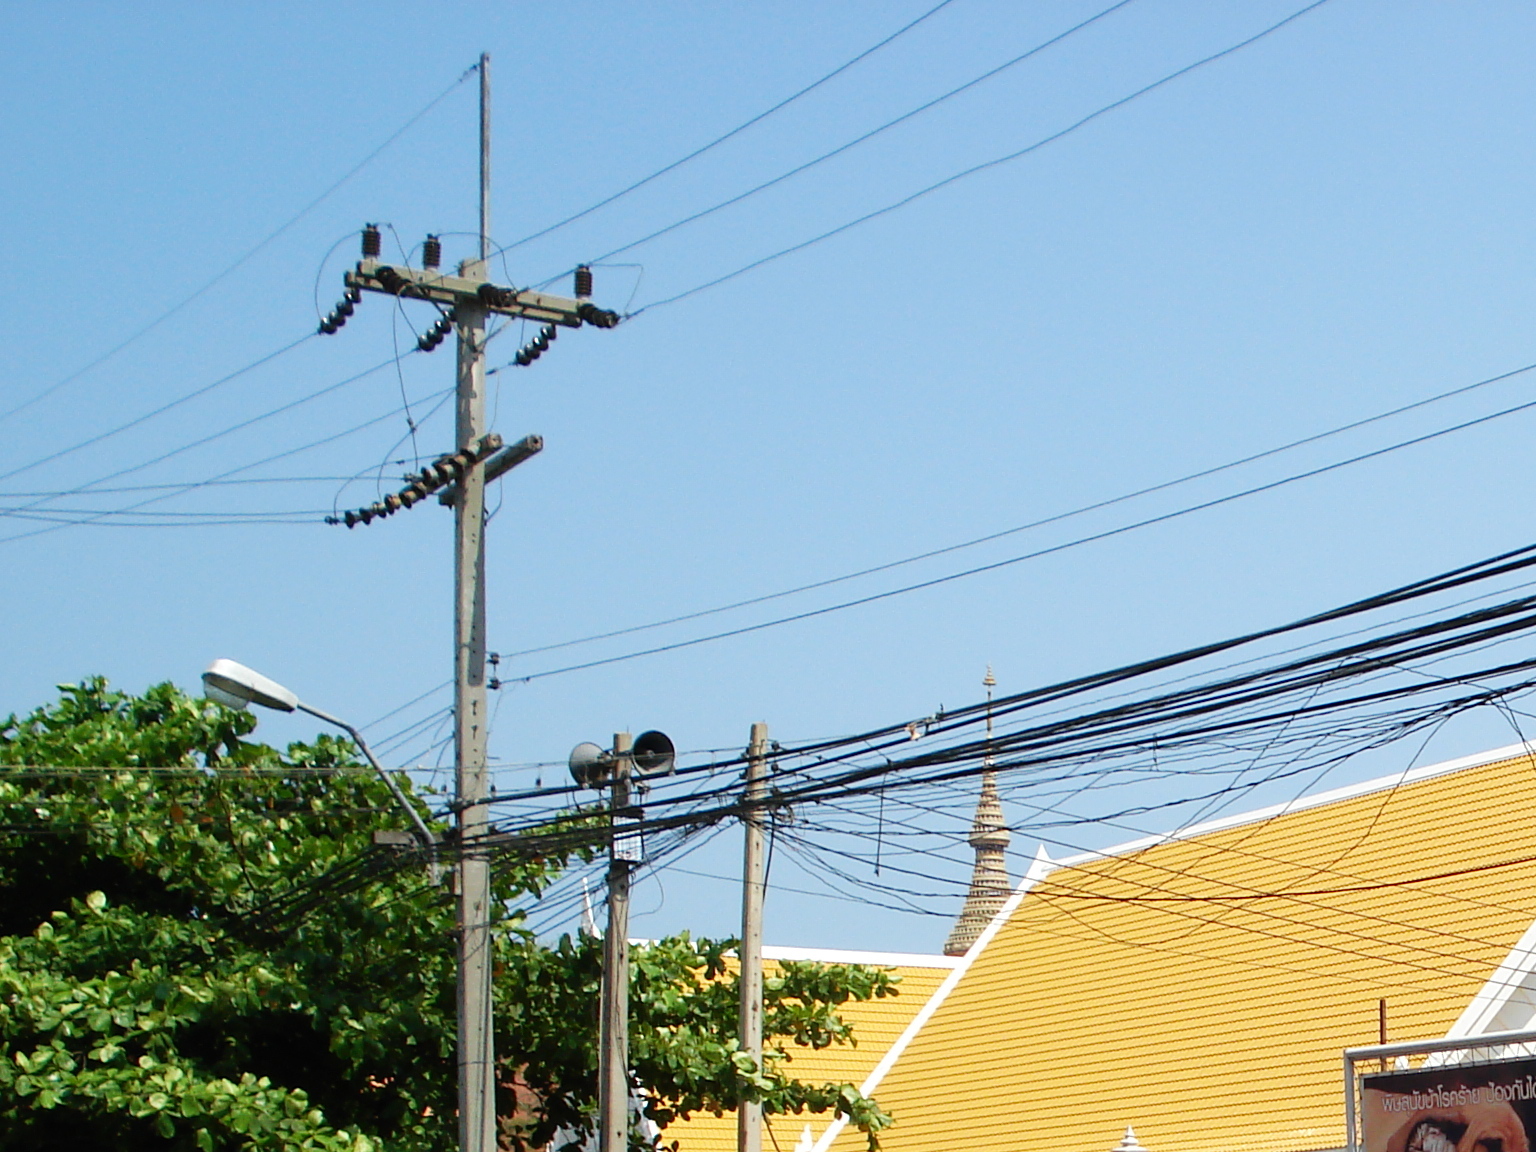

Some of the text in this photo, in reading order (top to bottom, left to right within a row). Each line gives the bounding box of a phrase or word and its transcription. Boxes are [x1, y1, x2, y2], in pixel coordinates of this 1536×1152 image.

[1382, 1083, 1480, 1116] พิษสุนัขบ้าโรคร้าย
